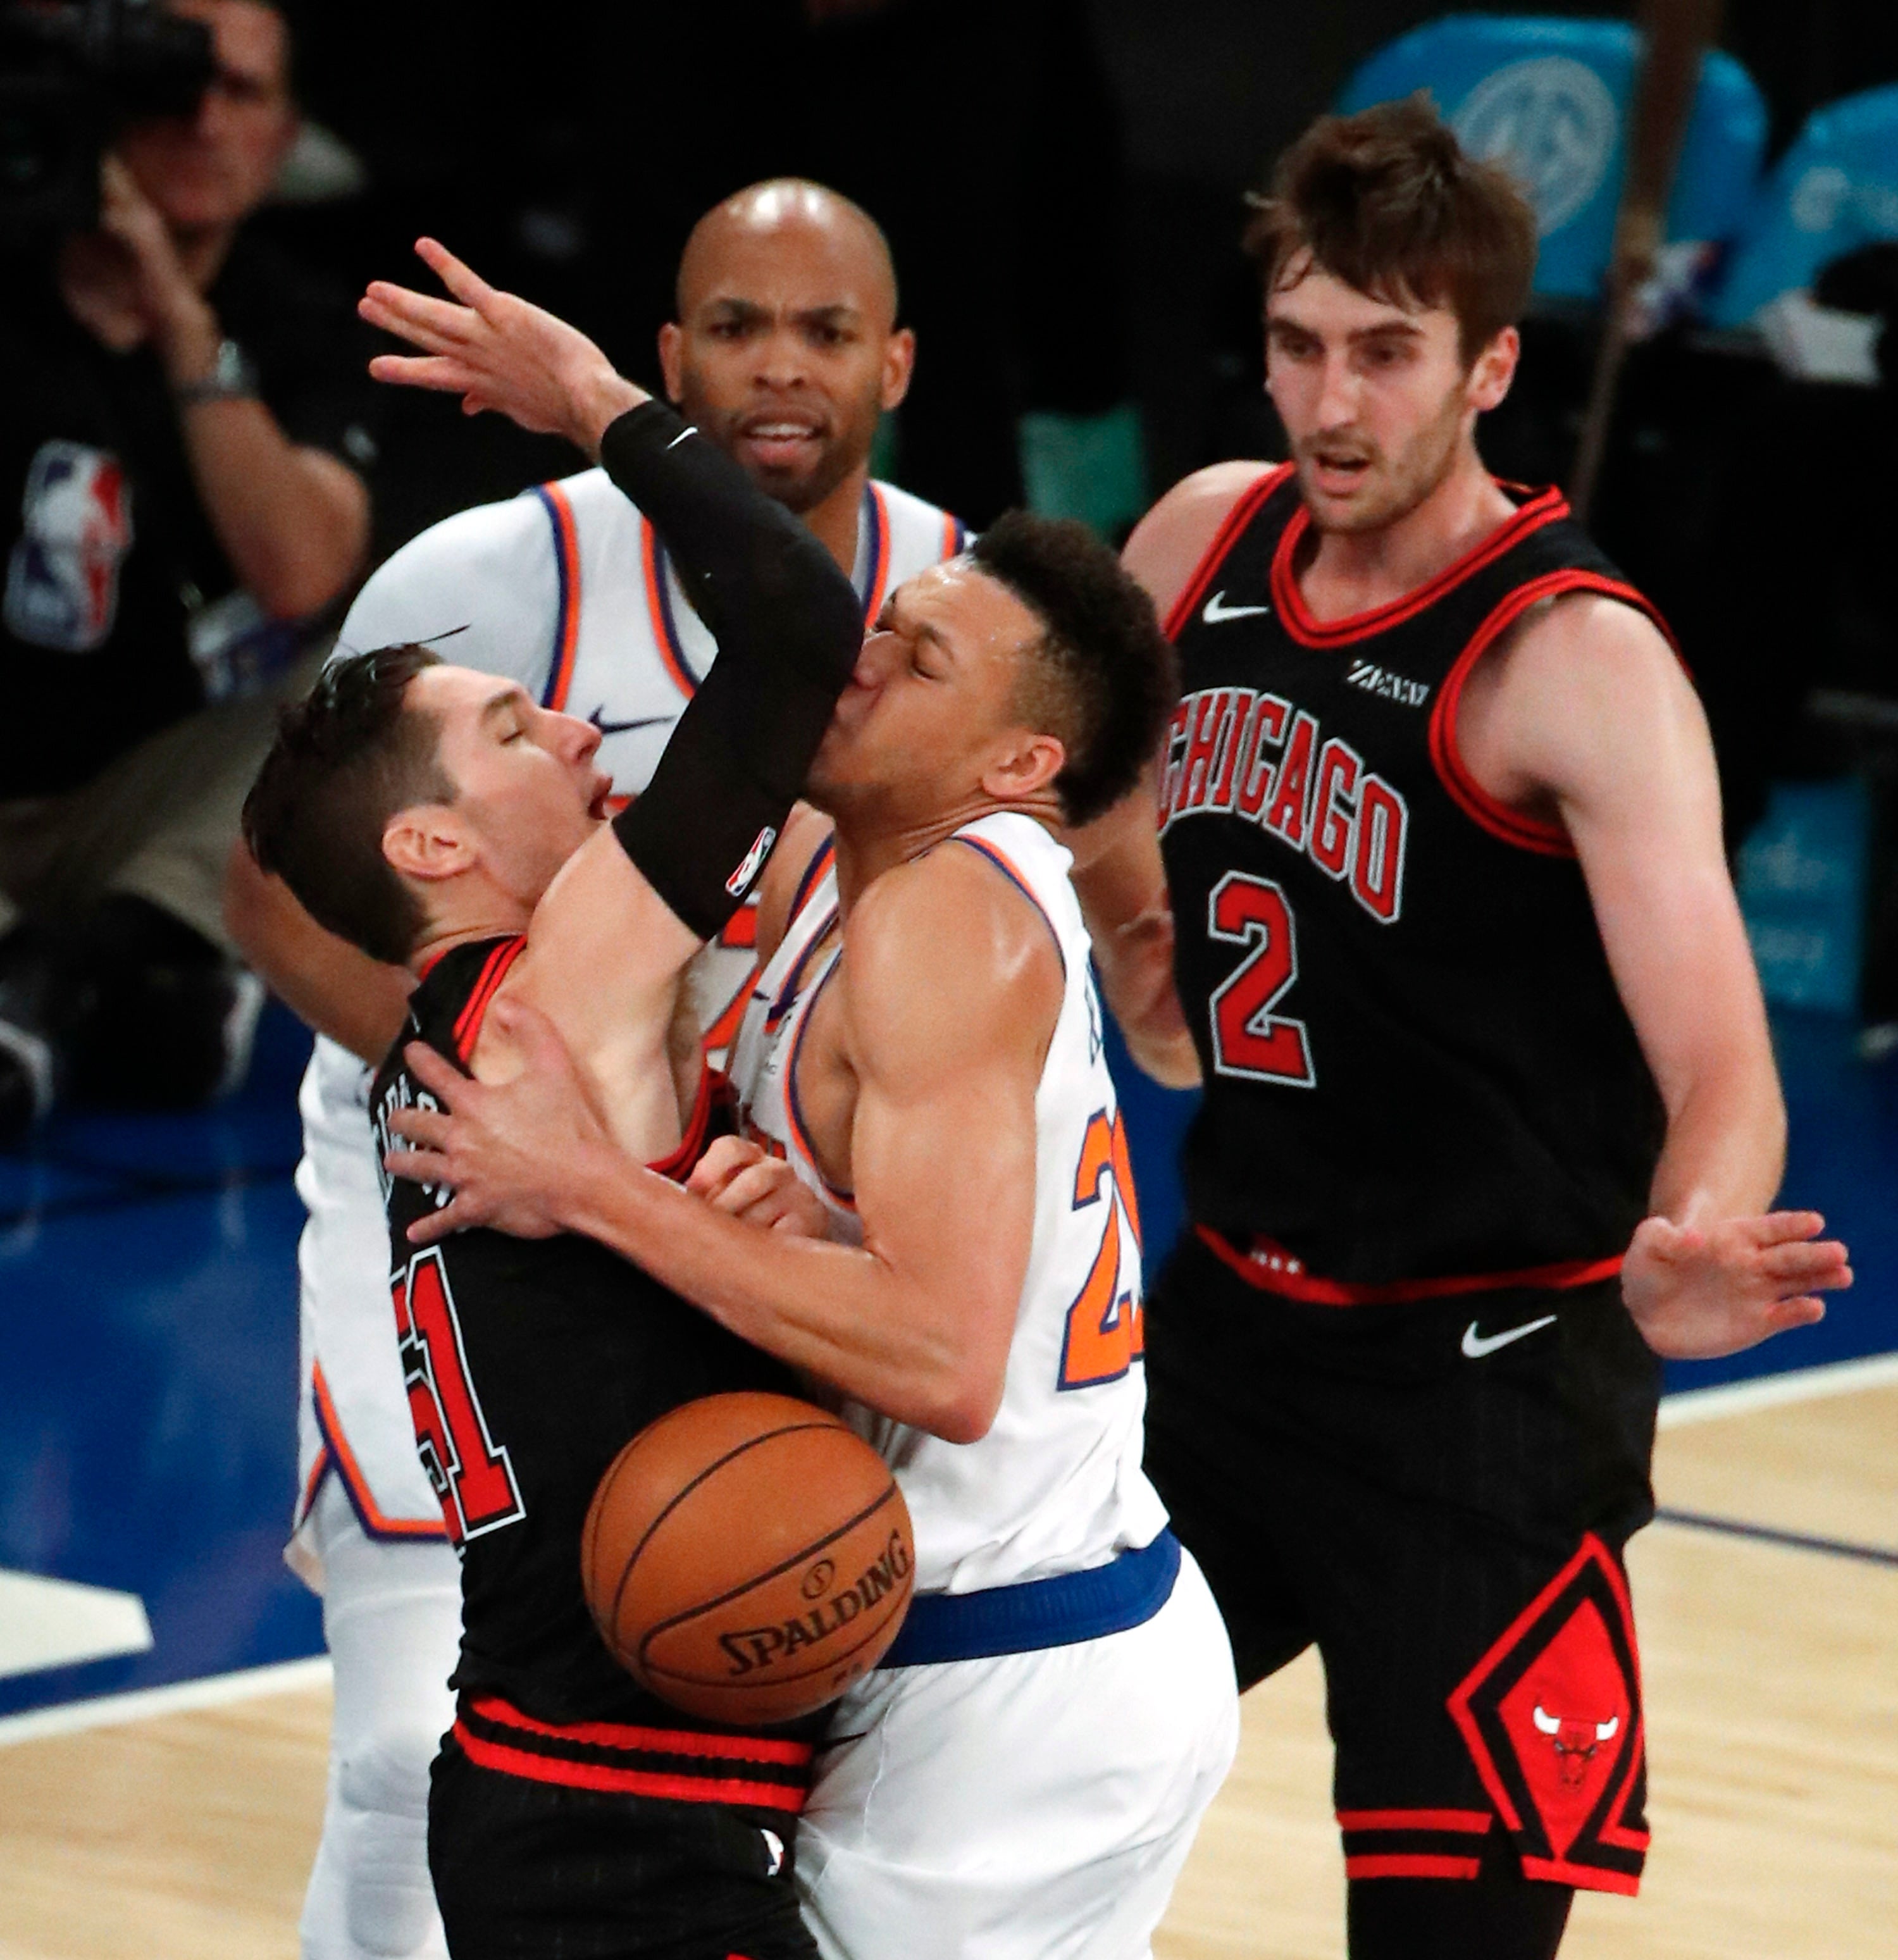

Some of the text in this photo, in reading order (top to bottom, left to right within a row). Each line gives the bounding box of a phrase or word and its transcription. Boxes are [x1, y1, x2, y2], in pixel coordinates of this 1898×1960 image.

[1157, 687, 1409, 925] CHICAGO
[1208, 869, 1317, 1089] 2
[718, 1528, 912, 1676] SPALDING
